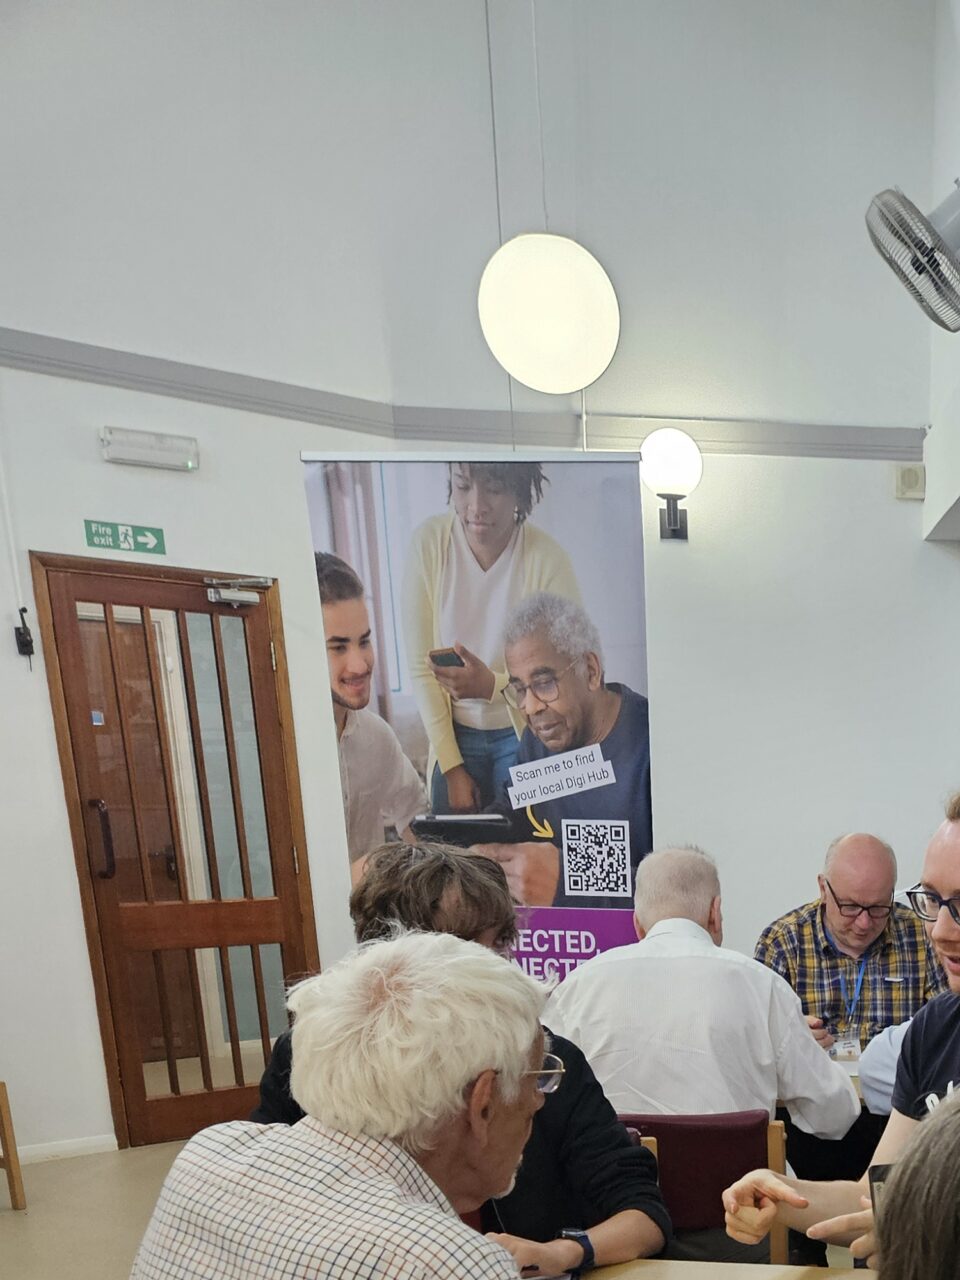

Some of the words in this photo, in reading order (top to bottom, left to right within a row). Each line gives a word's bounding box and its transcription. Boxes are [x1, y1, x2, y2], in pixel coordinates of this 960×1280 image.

[91, 523, 112, 535] Fire
[93, 535, 113, 546] exit
[516, 768, 542, 782] Scan
[545, 763, 561, 775] me
[562, 759, 573, 770] to
[575, 750, 595, 767] find
[514, 788, 540, 805] your
[539, 782, 564, 797] local
[565, 775, 586, 789] Digi
[587, 768, 609, 783] Hub
